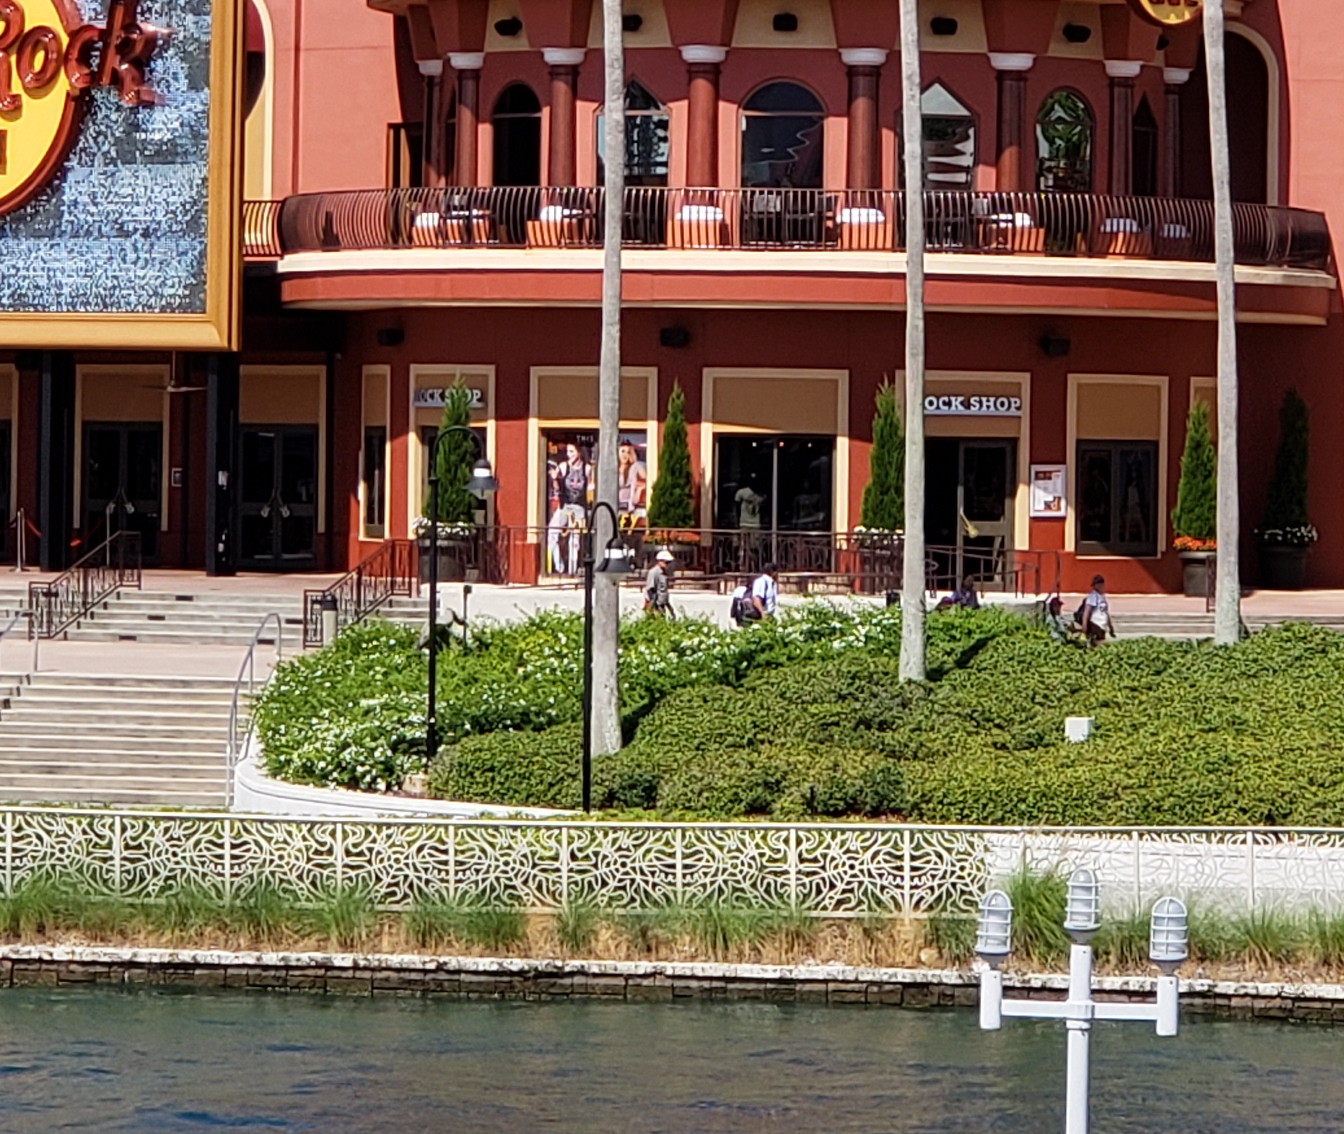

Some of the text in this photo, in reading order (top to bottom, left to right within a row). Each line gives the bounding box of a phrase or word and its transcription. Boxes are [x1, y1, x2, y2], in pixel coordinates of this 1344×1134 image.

[444, 388, 482, 404] SOP
[924, 395, 1021, 412] OCK SHOP
